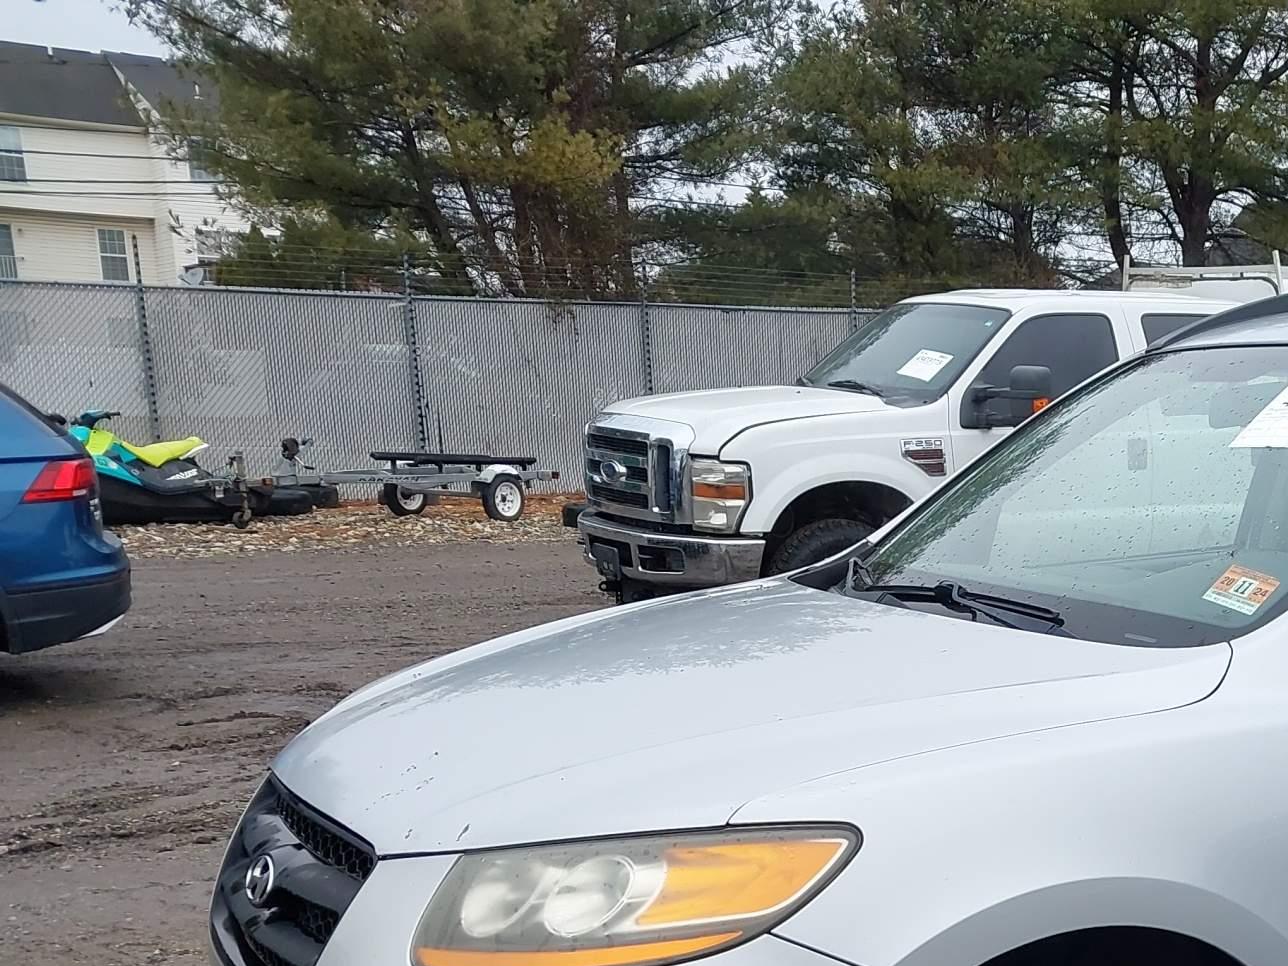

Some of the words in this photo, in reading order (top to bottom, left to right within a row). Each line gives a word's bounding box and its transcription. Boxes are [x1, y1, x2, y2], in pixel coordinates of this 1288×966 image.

[903, 440, 943, 448] F-250
[1220, 576, 1236, 586] 20
[1233, 580, 1254, 594] 11
[1253, 587, 1269, 597] 24
